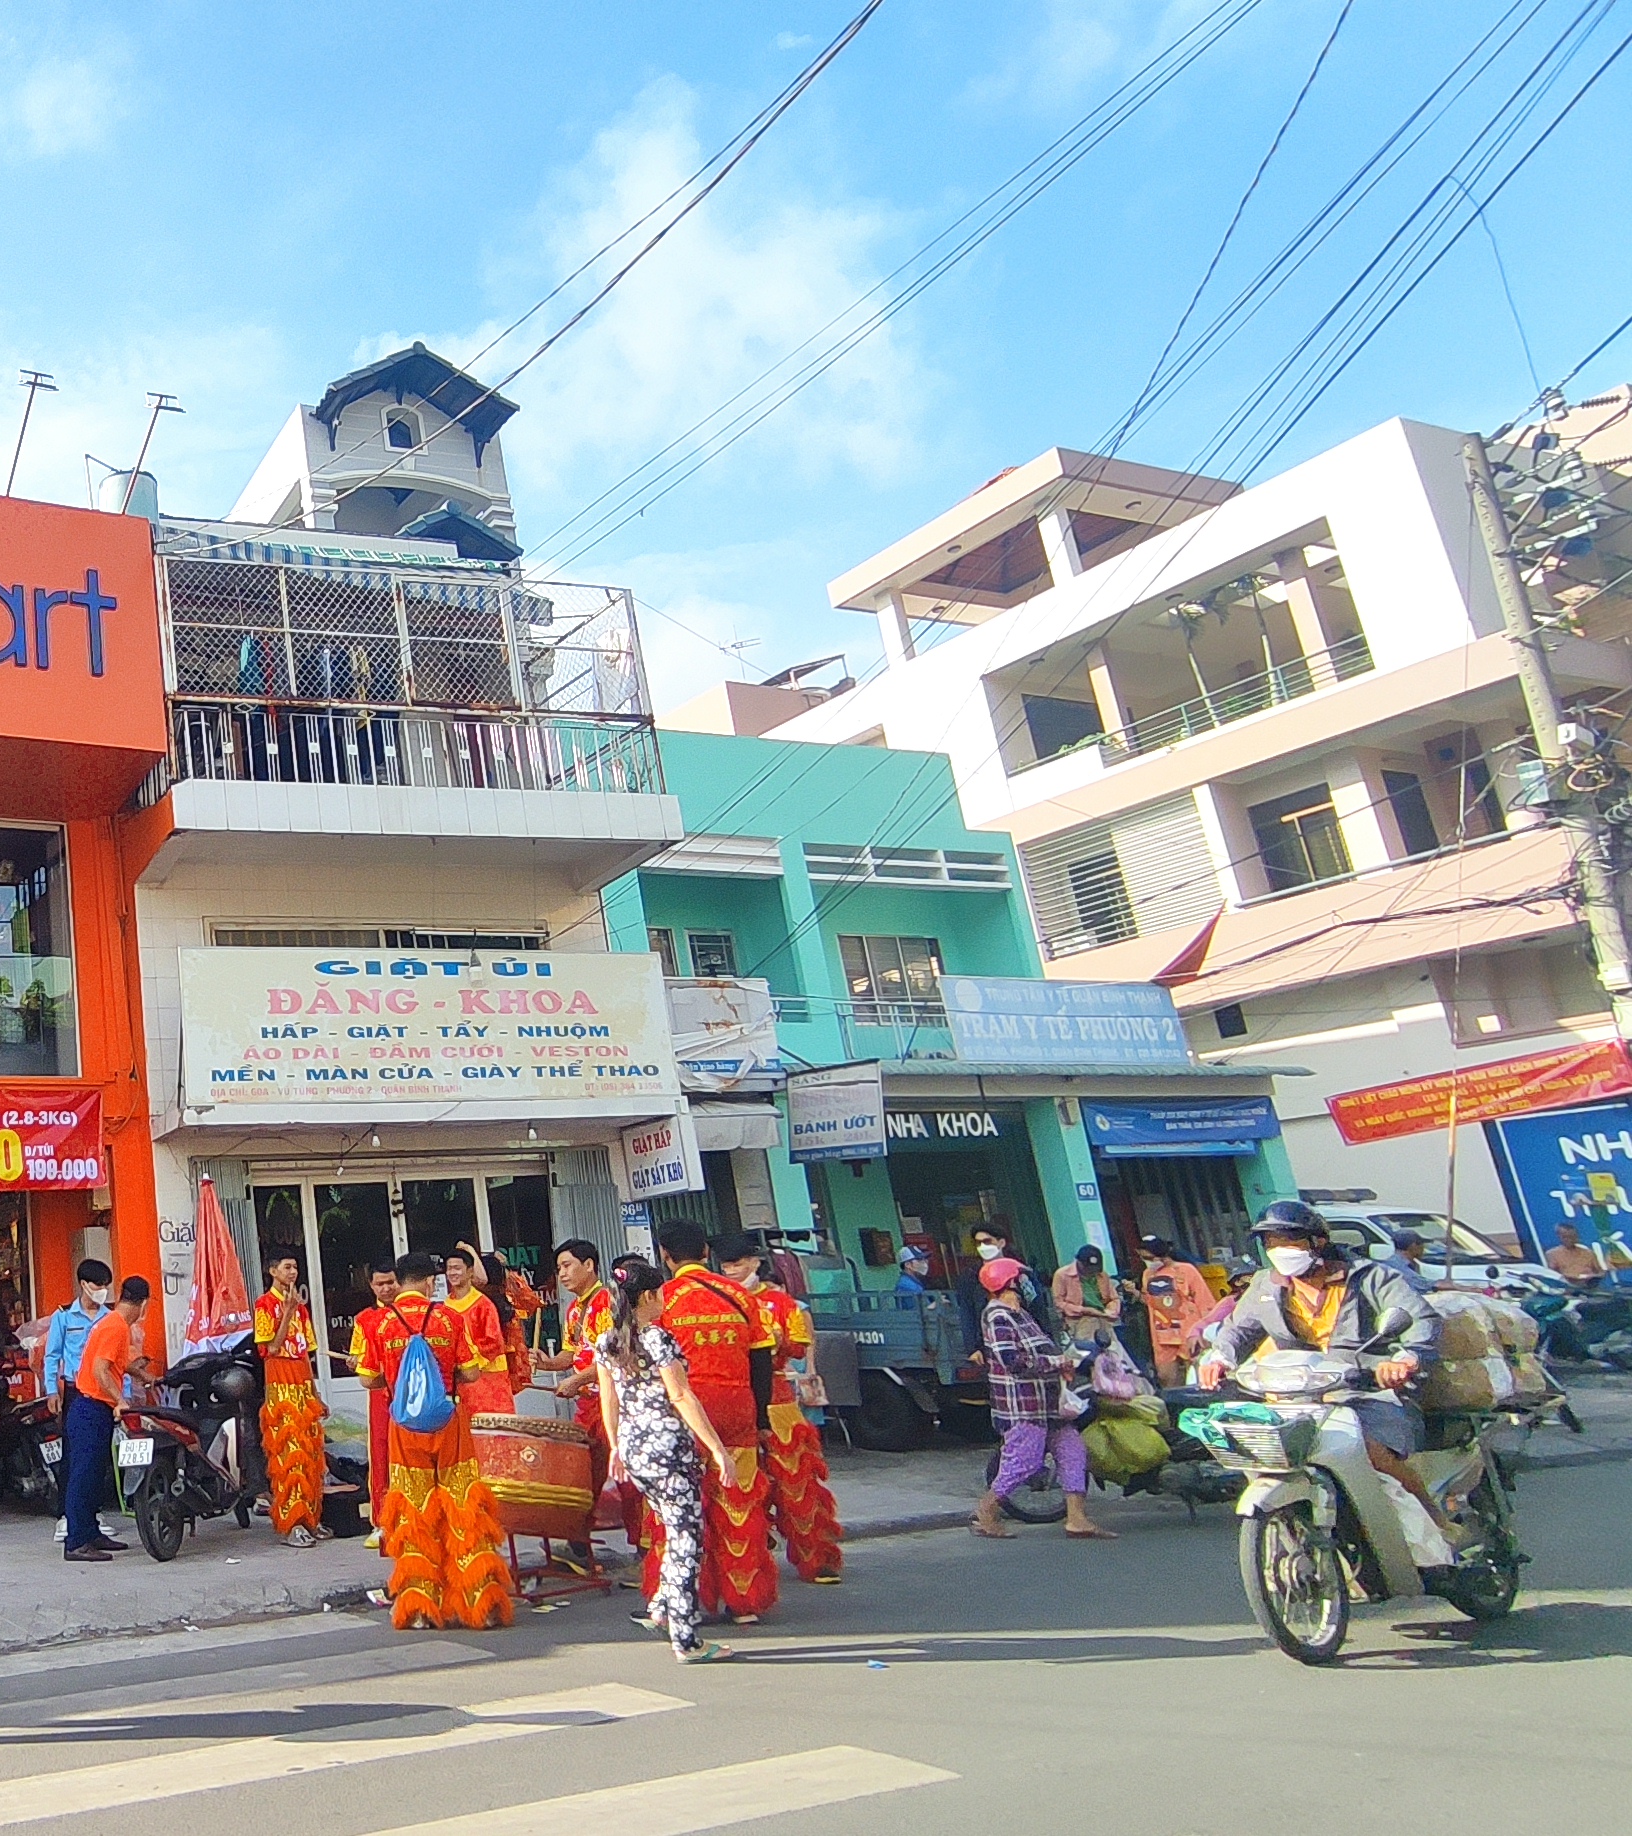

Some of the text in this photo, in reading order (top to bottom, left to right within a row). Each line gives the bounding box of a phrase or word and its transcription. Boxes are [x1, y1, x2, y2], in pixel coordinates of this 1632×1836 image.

[491, 957, 552, 977] ỦI
[266, 981, 599, 1015] ĐĂNG KHOA
[261, 1020, 610, 1042] HẤP GIẶT TẨY NHUỘM
[1022, 1015, 1039, 1040] Y
[1162, 1018, 1177, 1041] 2
[243, 1044, 282, 1060] ÁO
[292, 1044, 340, 1060] DÀI
[441, 1043, 503, 1059] CƯỚI
[530, 1045, 629, 1057] VESTON
[211, 1059, 660, 1082] MỀN MÀN CỬA GIÀY THỂ THAO
[2, 1108, 78, 1128] (2.8-3KG)
[793, 1114, 877, 1135] BÁNH ƯỚT
[887, 1112, 999, 1138] NHA KHOA
[1079, 1184, 1094, 1196] 60
